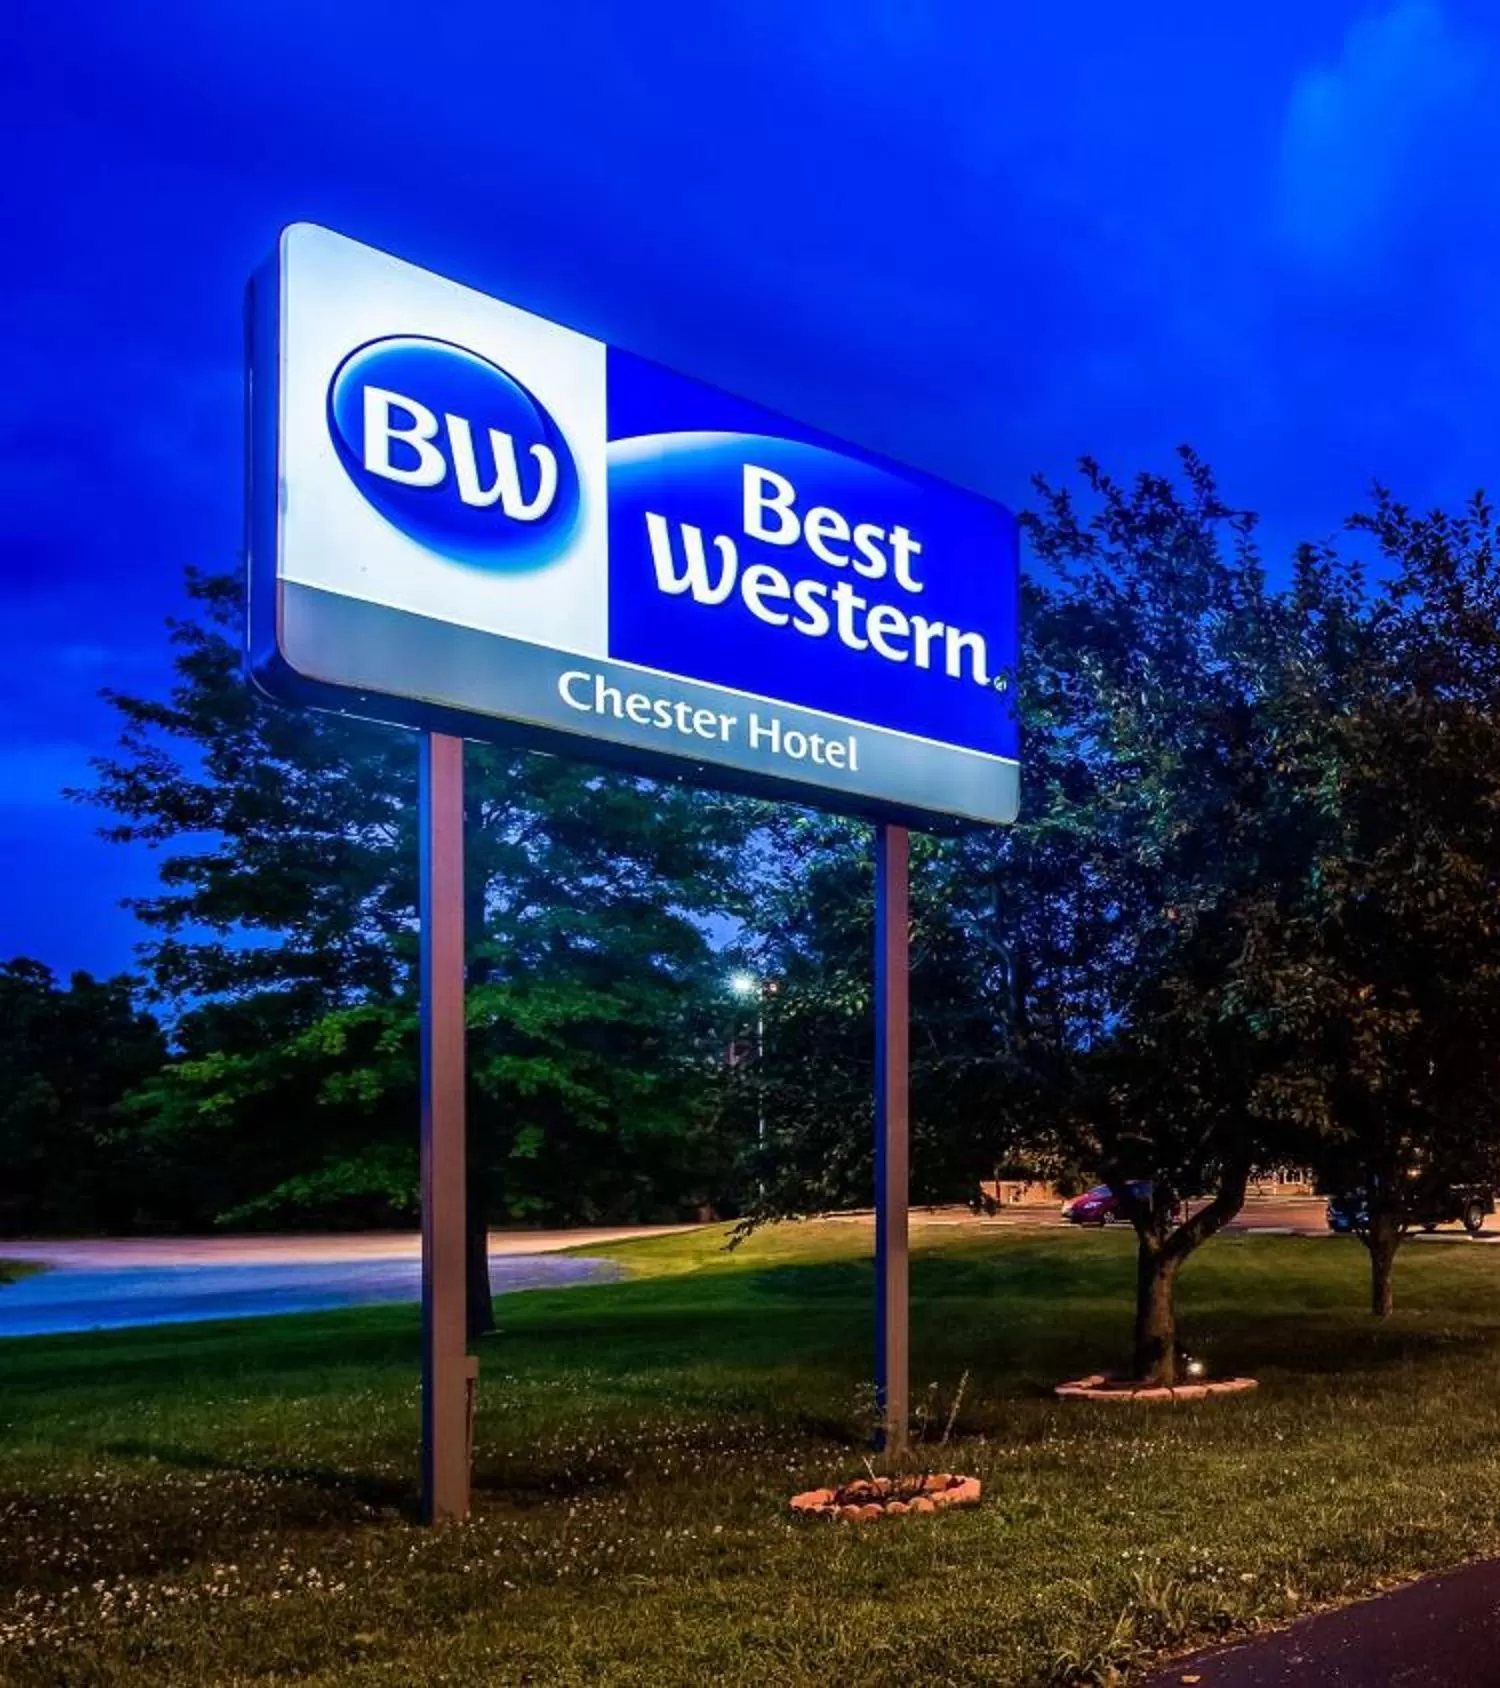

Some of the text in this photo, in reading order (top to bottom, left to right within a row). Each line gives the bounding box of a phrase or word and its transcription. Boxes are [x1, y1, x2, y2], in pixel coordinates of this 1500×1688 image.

[361, 384, 558, 522] BW
[742, 463, 924, 593] Best
[557, 670, 858, 772] Chester Hotel
